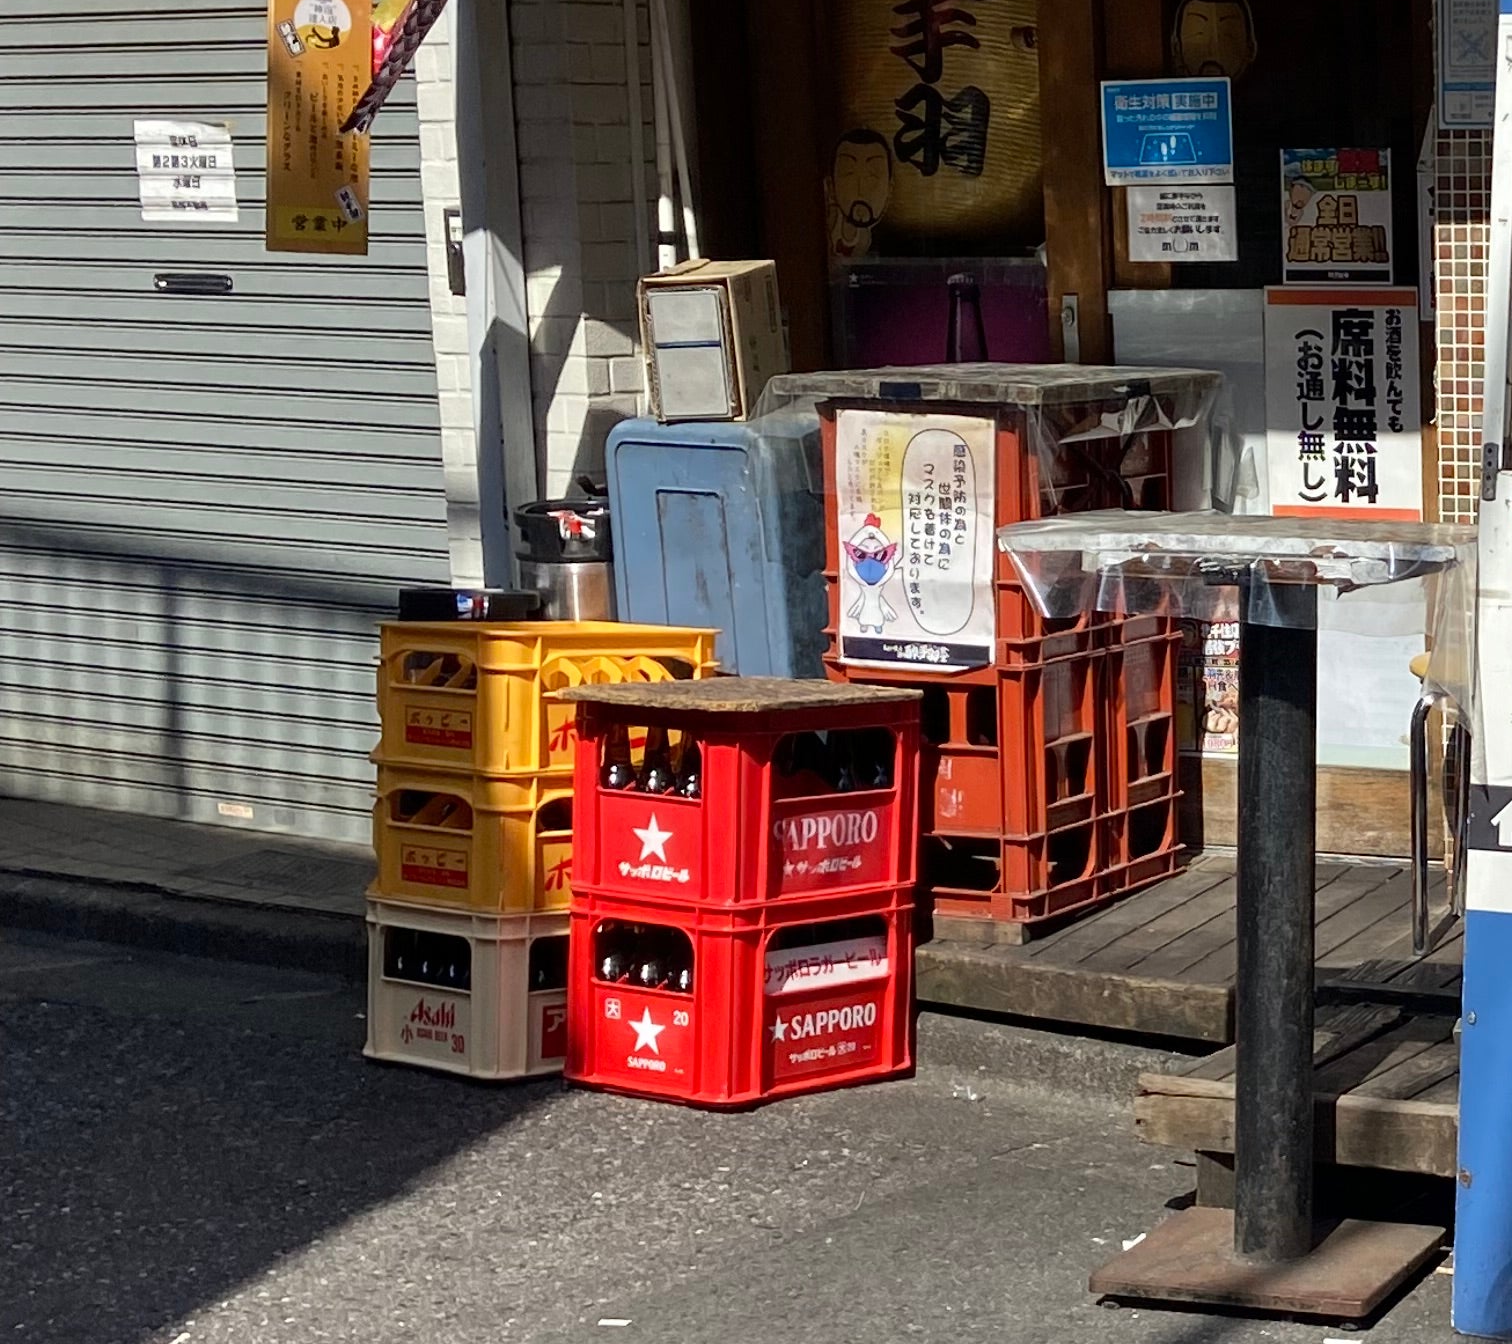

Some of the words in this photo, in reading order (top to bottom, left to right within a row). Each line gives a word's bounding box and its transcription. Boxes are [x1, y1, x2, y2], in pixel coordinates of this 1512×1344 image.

[1331, 308, 1379, 504] 席料無料
[773, 810, 879, 853] SAPPORO
[619, 861, 691, 883] サッポロビール
[410, 997, 456, 1029] Asahi
[673, 1009, 689, 1027] 20
[790, 1002, 877, 1041] SAPPORO
[451, 1034, 465, 1054] 30
[627, 1055, 667, 1072] SAPPORO
